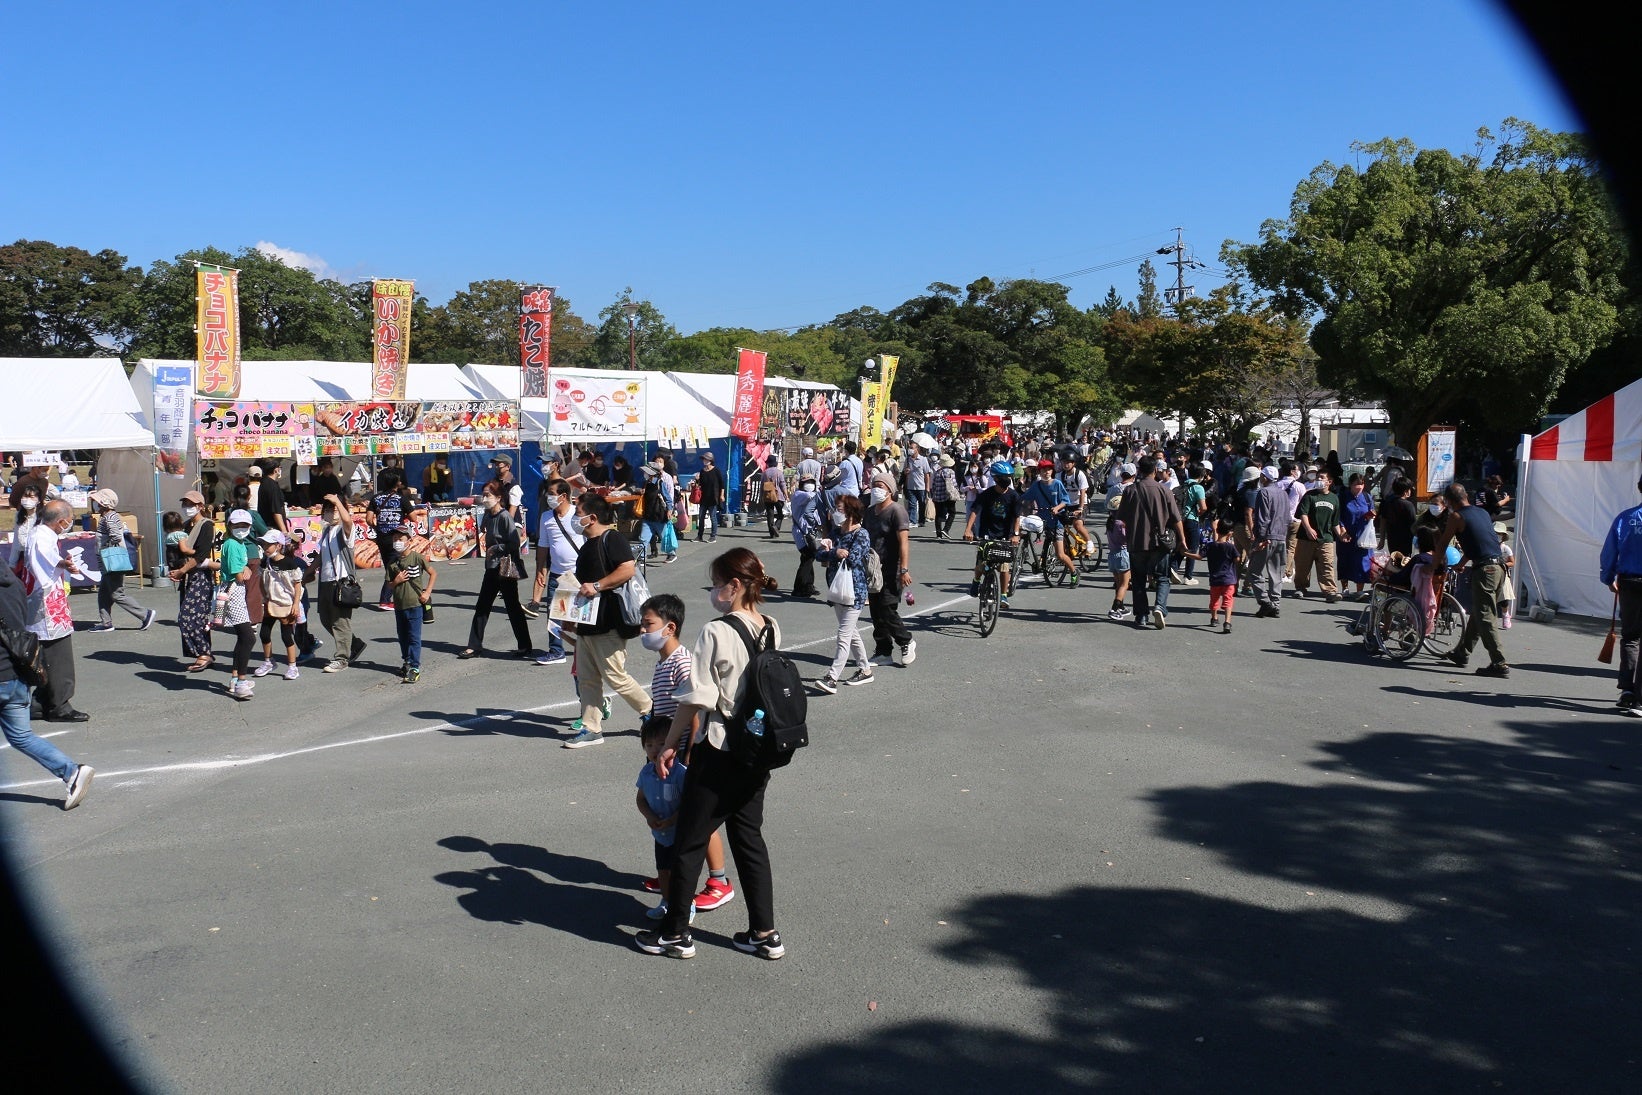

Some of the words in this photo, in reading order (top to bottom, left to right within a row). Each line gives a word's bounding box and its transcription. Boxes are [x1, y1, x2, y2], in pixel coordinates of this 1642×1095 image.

[375, 283, 411, 297] 味自慢
[204, 272, 229, 392] チョコバナナ
[375, 298, 400, 396] いか焼き
[521, 315, 546, 396] たこ焼
[160, 395, 171, 443] 青年部
[173, 388, 184, 438] 音羽商工会
[200, 407, 288, 430] チョコバナナ
[338, 408, 407, 430] イカ焼き
[202, 459, 216, 468] 23
